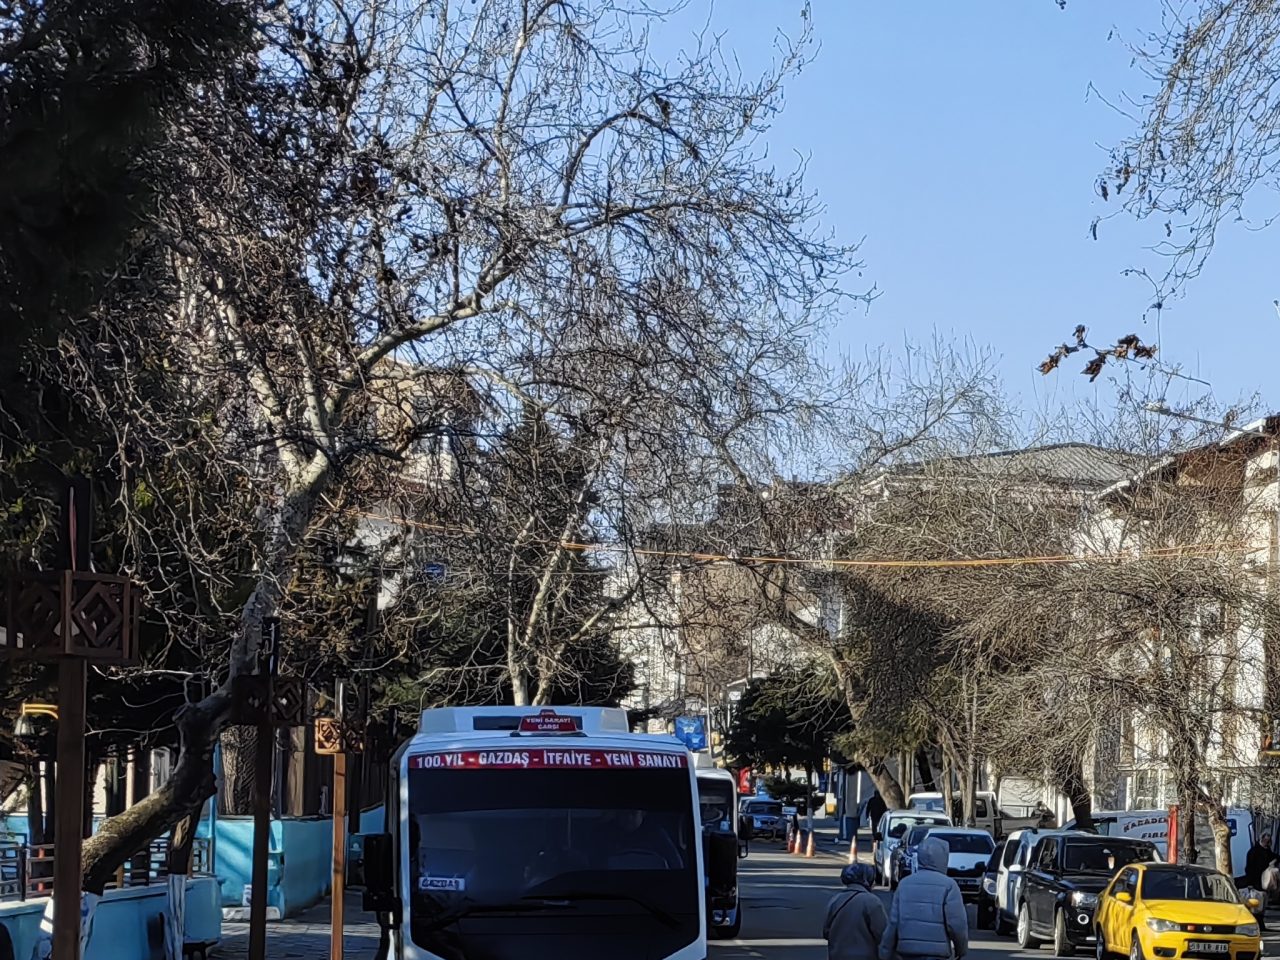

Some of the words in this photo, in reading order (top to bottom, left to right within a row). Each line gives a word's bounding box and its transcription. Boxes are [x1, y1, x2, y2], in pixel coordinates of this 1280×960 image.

[479, 752, 529, 768] GAZDAŞ
[543, 750, 592, 765] İTFAİYE
[604, 751, 634, 766] YENİ
